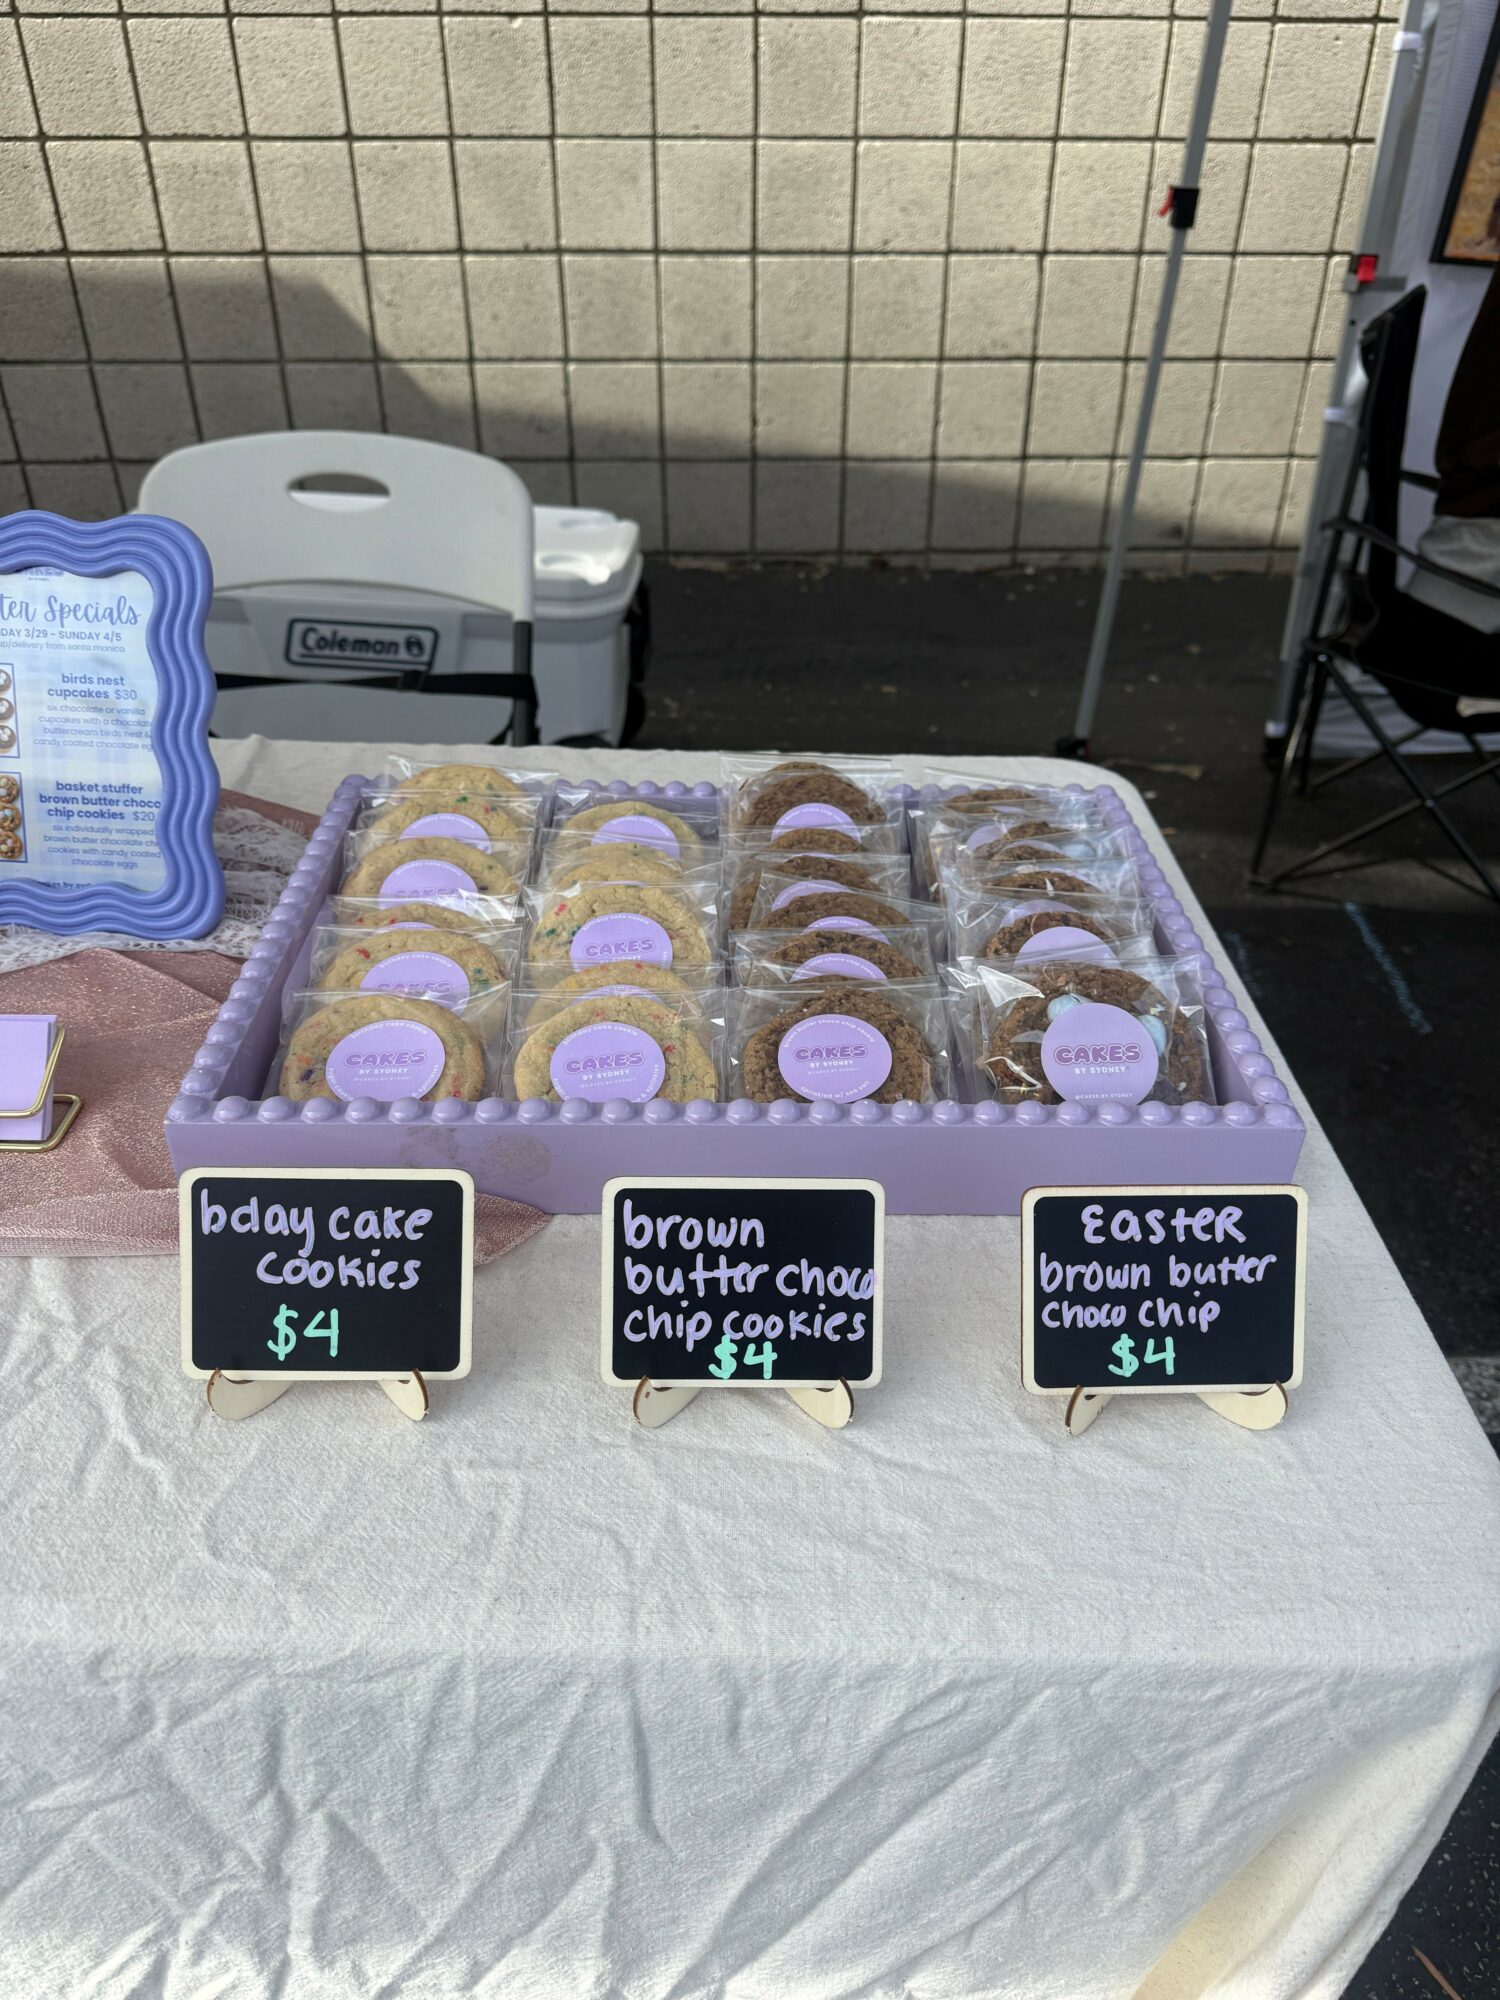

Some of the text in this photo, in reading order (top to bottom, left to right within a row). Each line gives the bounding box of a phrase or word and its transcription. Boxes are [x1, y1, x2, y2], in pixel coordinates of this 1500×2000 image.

[44, 595, 142, 628] Specials
[0, 627, 21, 638] DAY
[24, 627, 48, 639] 3/29
[58, 630, 101, 641] SUNDAY
[103, 630, 122, 643] 4/5
[302, 626, 399, 656] Coleman
[45, 641, 66, 649] from
[68, 643, 92, 651] santa
[93, 644, 125, 653] monica
[61, 673, 125, 686] birds nest
[48, 688, 137, 701] cupcakes $30
[60, 705, 104, 713] chocolate
[117, 707, 146, 716] vanilla
[39, 716, 80, 725] cupcakes
[83, 717, 101, 725] with
[124, 731, 142, 739] nest
[33, 738, 61, 748] candy
[63, 739, 94, 748] coated
[96, 741, 139, 749] chocolate
[56, 780, 144, 795] basket stuffer
[40, 793, 79, 805] brown
[82, 795, 121, 807] butter
[47, 807, 156, 822] chip cookies $20
[65, 825, 113, 835] individually
[115, 828, 154, 837] wrapped
[72, 836, 98, 844] butter
[100, 838, 143, 846] chocolate
[47, 847, 161, 859] cookies with candy coated
[71, 858, 139, 871] chocolate eggs
[583, 938, 657, 959] CAKES
[344, 1049, 428, 1067] CAKES
[794, 1044, 868, 1062] CAKES
[1055, 1043, 1142, 1066] CAKES
[564, 1050, 645, 1075] CAKES
[374, 1067, 409, 1075] SYDNEY
[597, 1069, 631, 1079] SYDNEY
[1074, 1066, 1126, 1075] BY SYDNEY
[201, 1188, 433, 1258] bday cake
[623, 1199, 765, 1249] brown
[624, 1253, 770, 1298] butter
[1040, 1252, 1278, 1293] brown butter
[1041, 1290, 1221, 1333] choco chip
[267, 1303, 340, 1362] $4
[623, 1300, 867, 1352] chip cookies
[708, 1334, 778, 1380] $4
[1107, 1333, 1176, 1377] $4
